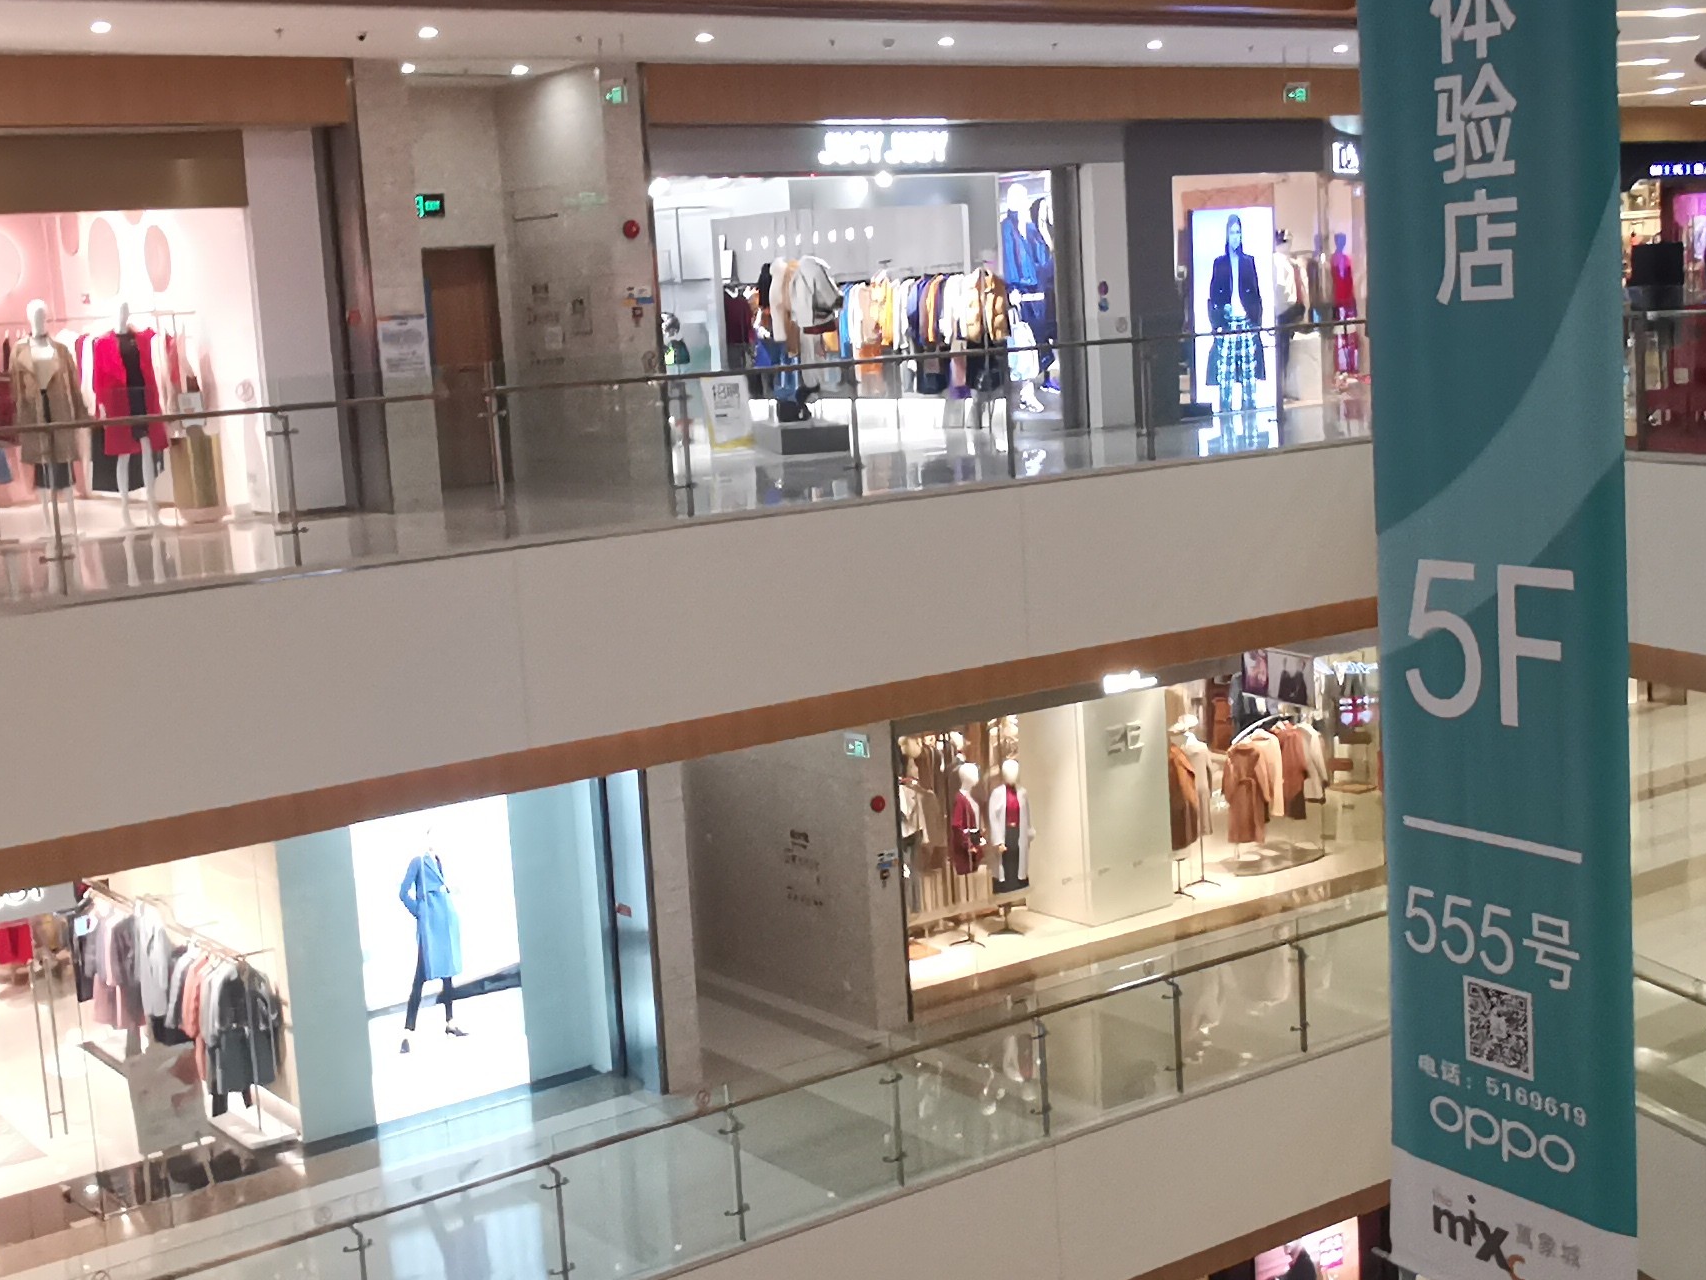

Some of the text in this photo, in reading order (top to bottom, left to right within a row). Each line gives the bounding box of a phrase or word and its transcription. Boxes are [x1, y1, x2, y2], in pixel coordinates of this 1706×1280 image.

[1404, 558, 1576, 729] 5F
[1402, 886, 1581, 991] 555号
[1429, 1095, 1576, 1173] oppo
